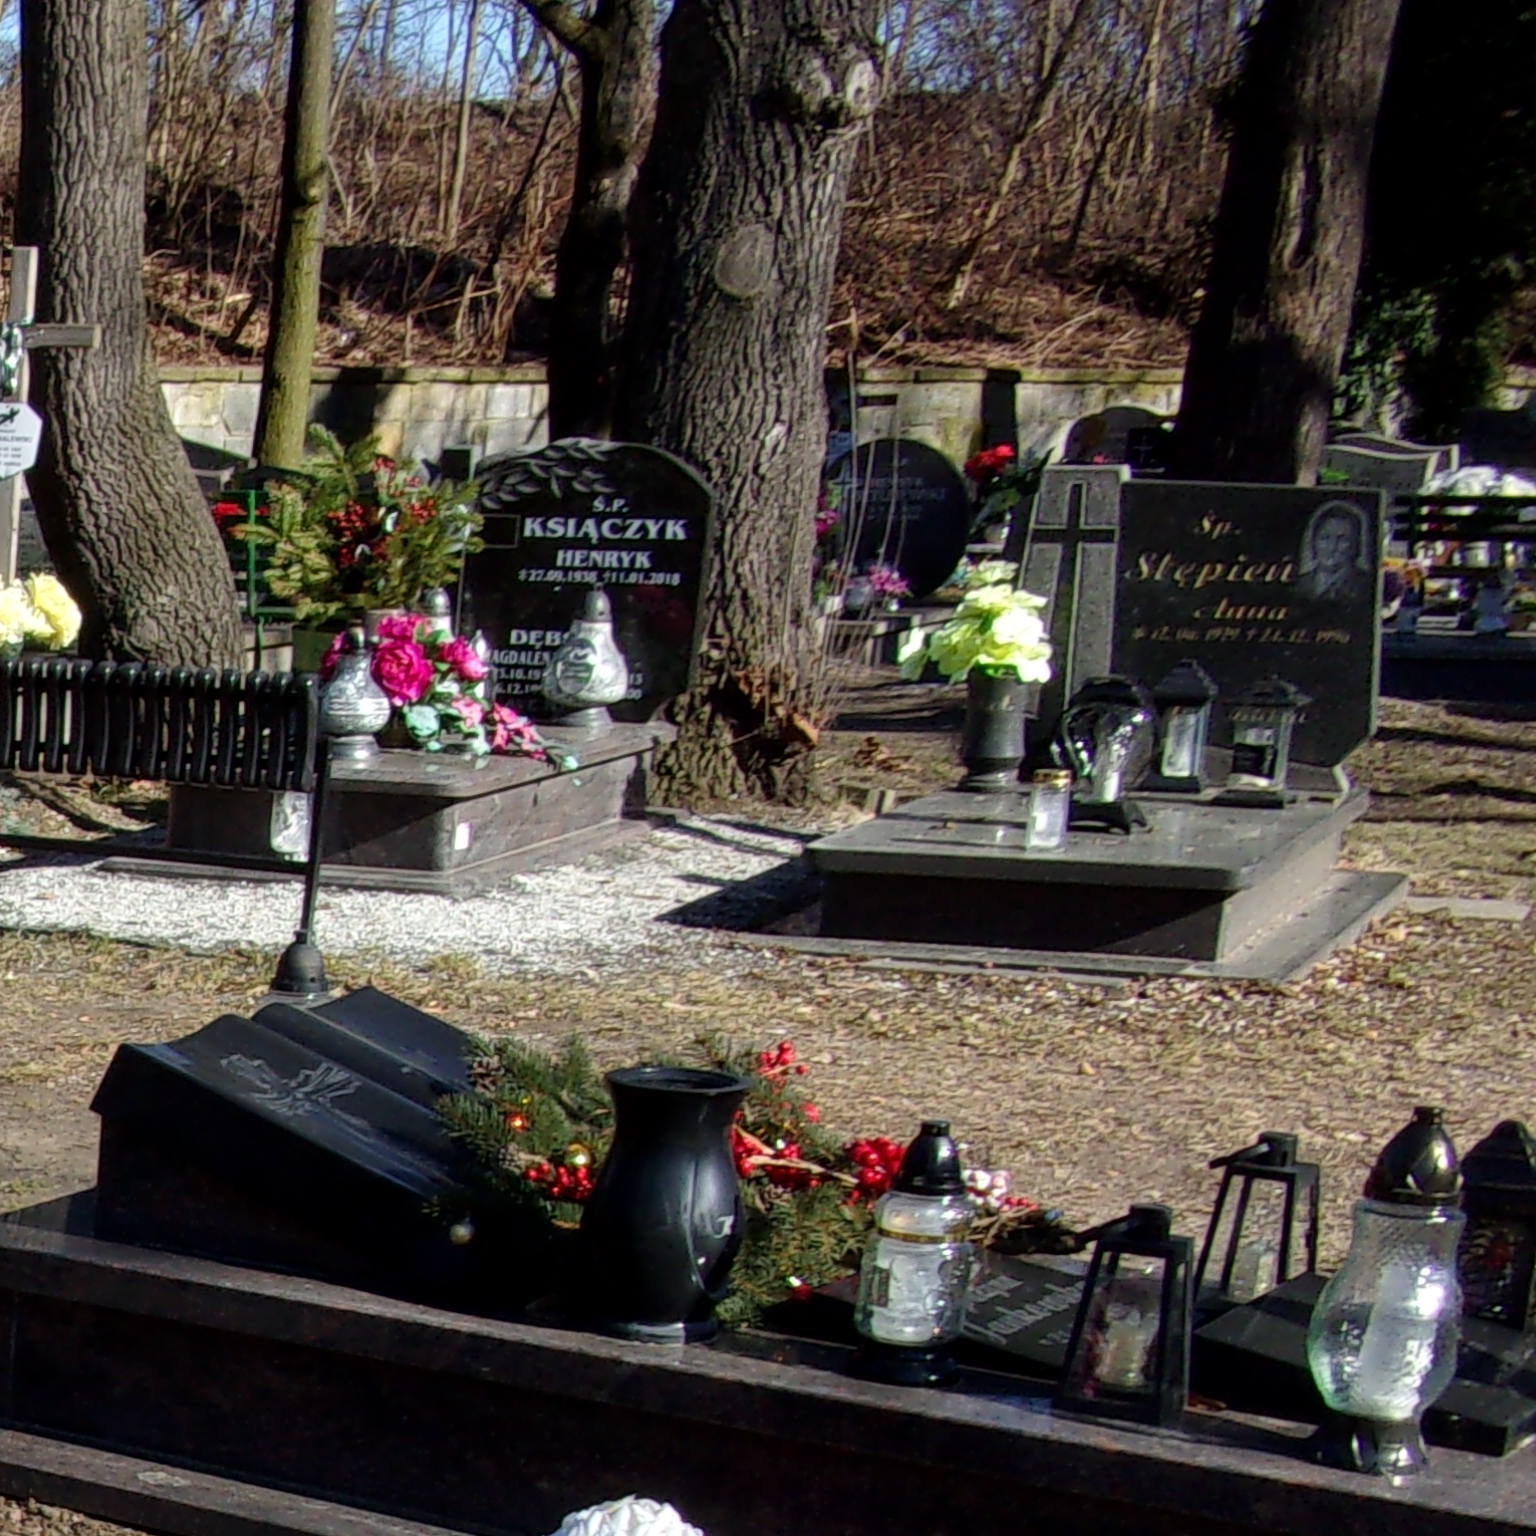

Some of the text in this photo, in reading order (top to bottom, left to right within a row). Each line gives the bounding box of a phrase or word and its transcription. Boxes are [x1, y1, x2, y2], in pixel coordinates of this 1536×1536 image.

[523, 516, 688, 544] KSIĄCZYK
[556, 550, 652, 569] HENRYK
[510, 629, 565, 649] DĘB
[486, 649, 551, 665] AGDALEN
